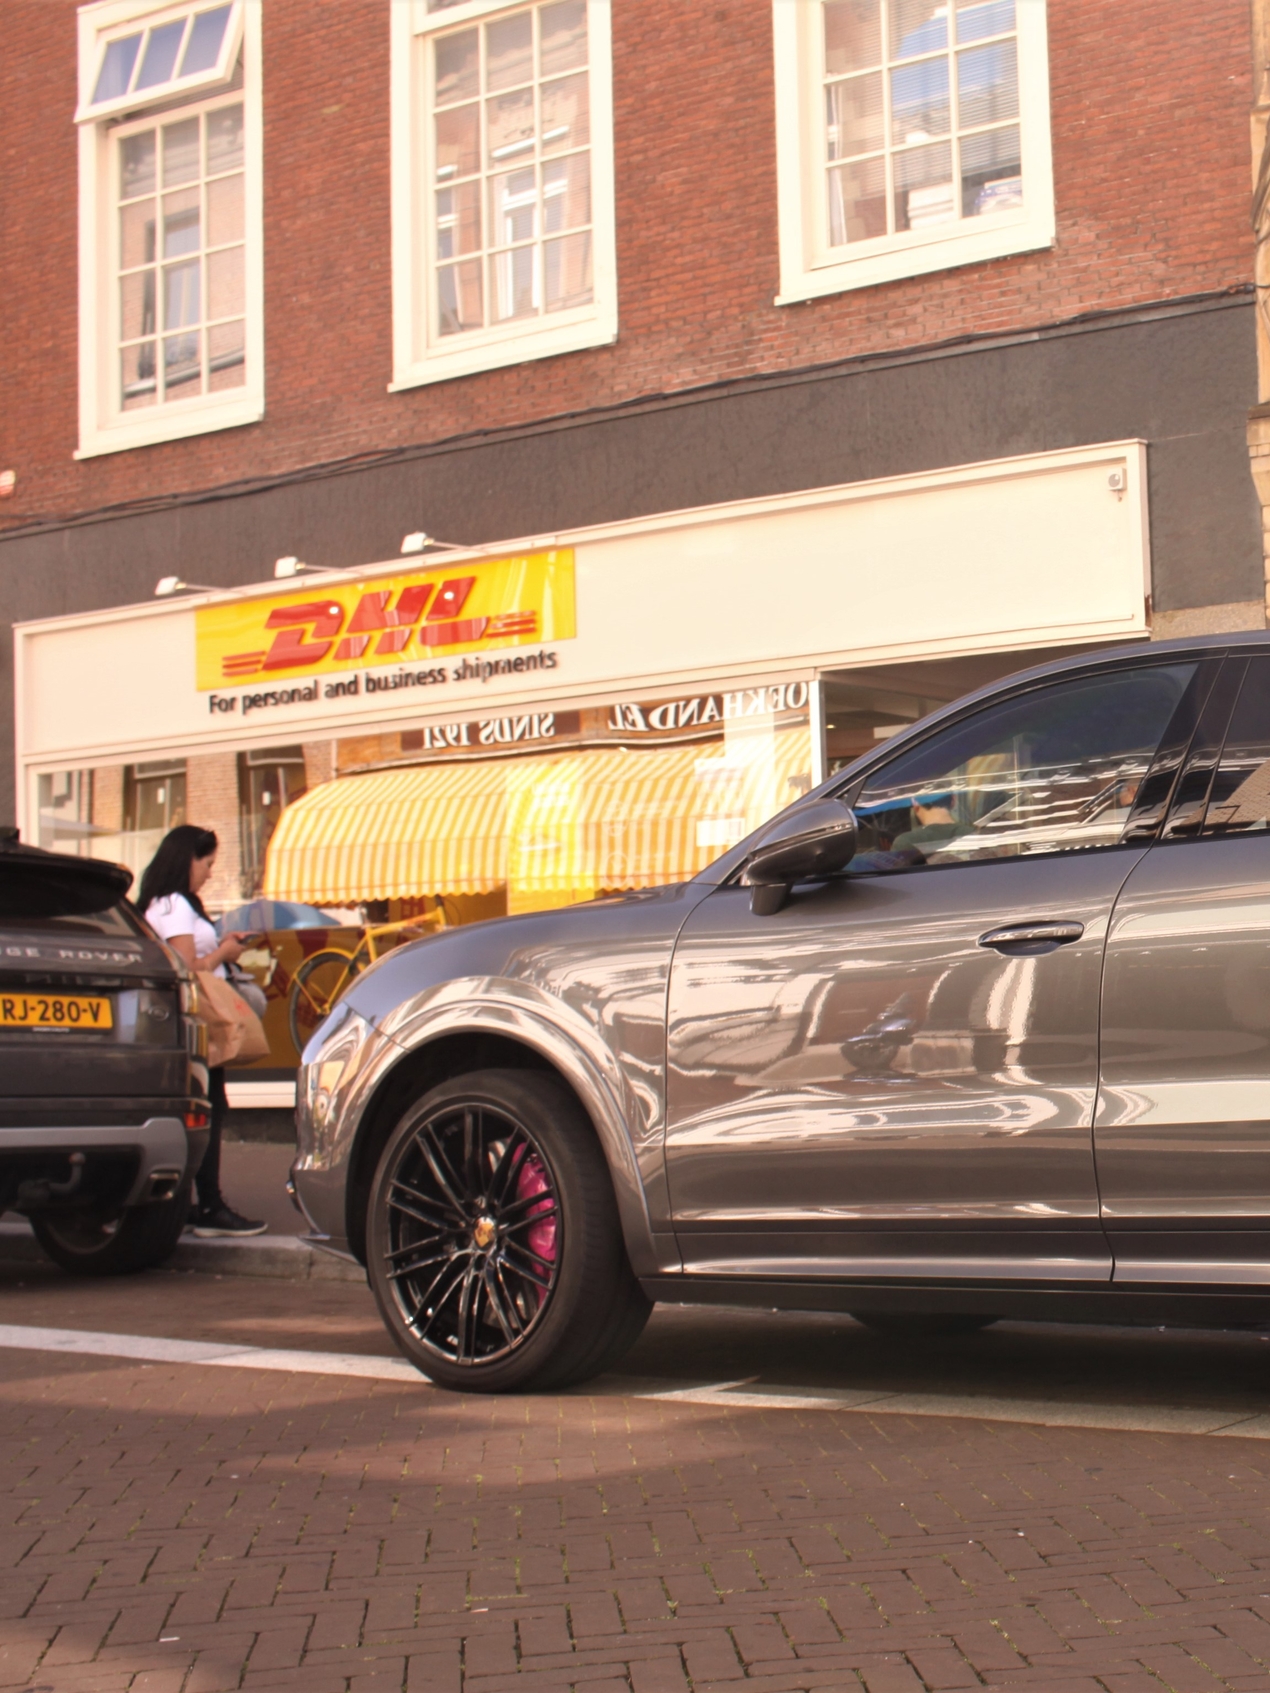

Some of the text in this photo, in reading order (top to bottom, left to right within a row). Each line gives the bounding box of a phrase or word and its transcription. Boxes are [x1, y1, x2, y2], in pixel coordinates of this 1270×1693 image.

[262, 576, 492, 671] DHL
[209, 650, 558, 715] For personal and business shipments
[0, 947, 143, 963] GE ROVER
[2, 998, 101, 1023] RJ-280-V
